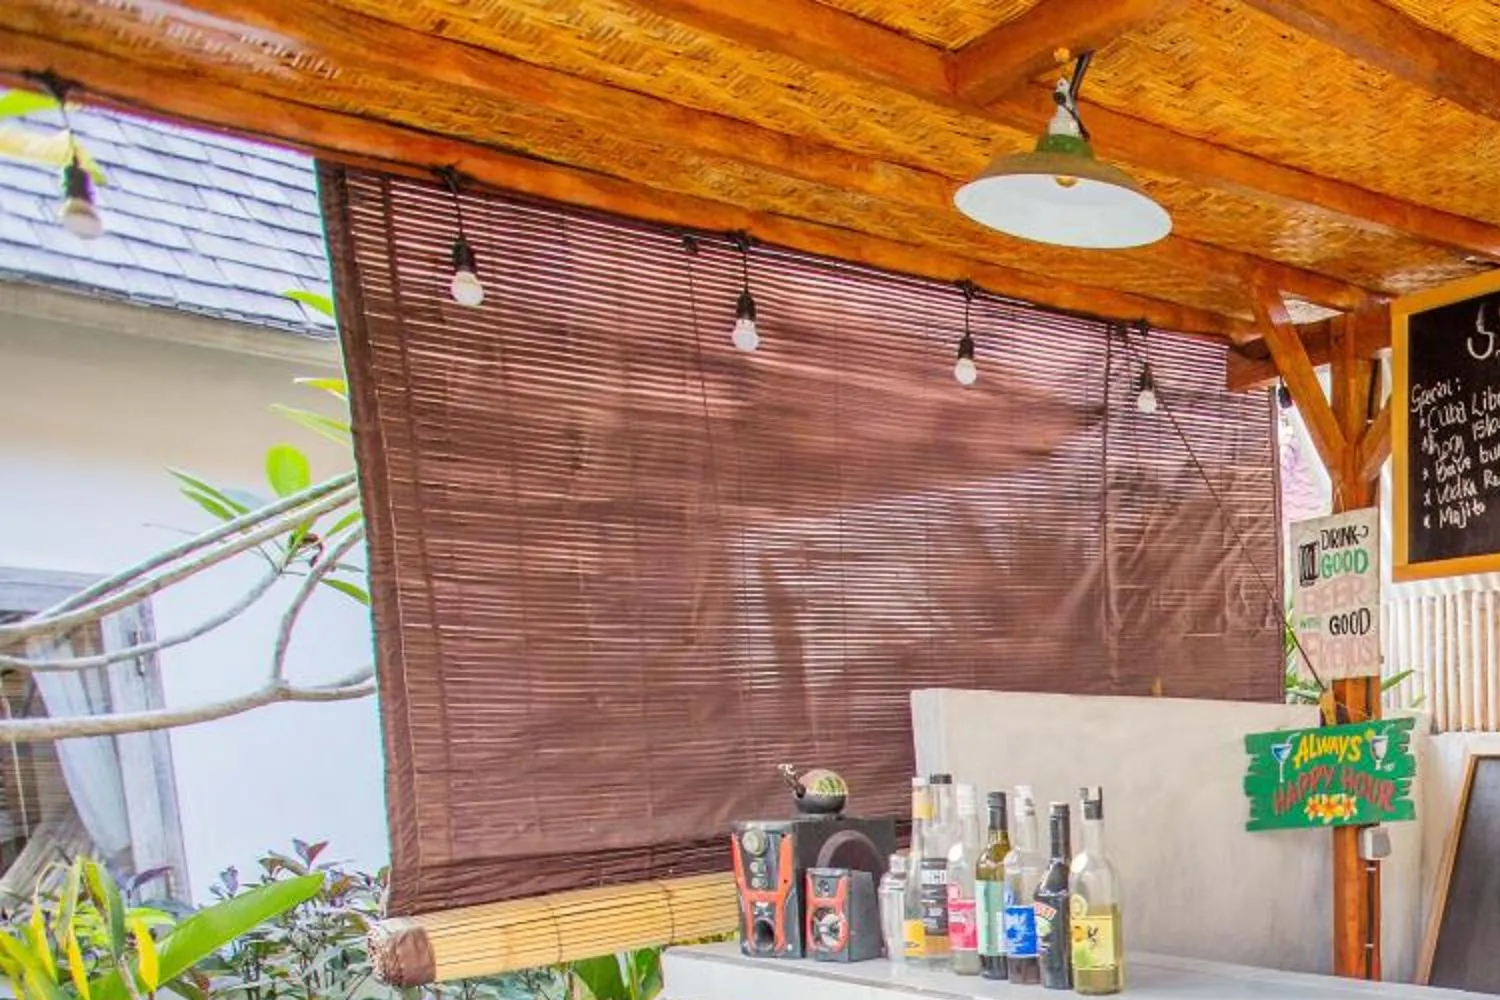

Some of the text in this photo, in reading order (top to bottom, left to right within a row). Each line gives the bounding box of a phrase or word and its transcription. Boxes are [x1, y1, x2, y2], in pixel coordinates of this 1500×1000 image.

[1320, 525, 1369, 550] DRINK
[1321, 548, 1369, 579] GOOD
[1303, 576, 1369, 614] BEER
[1329, 607, 1371, 636] GOOD
[1293, 733, 1362, 769] ALWAYS
[1274, 765, 1396, 815] HAPPY HOUR
